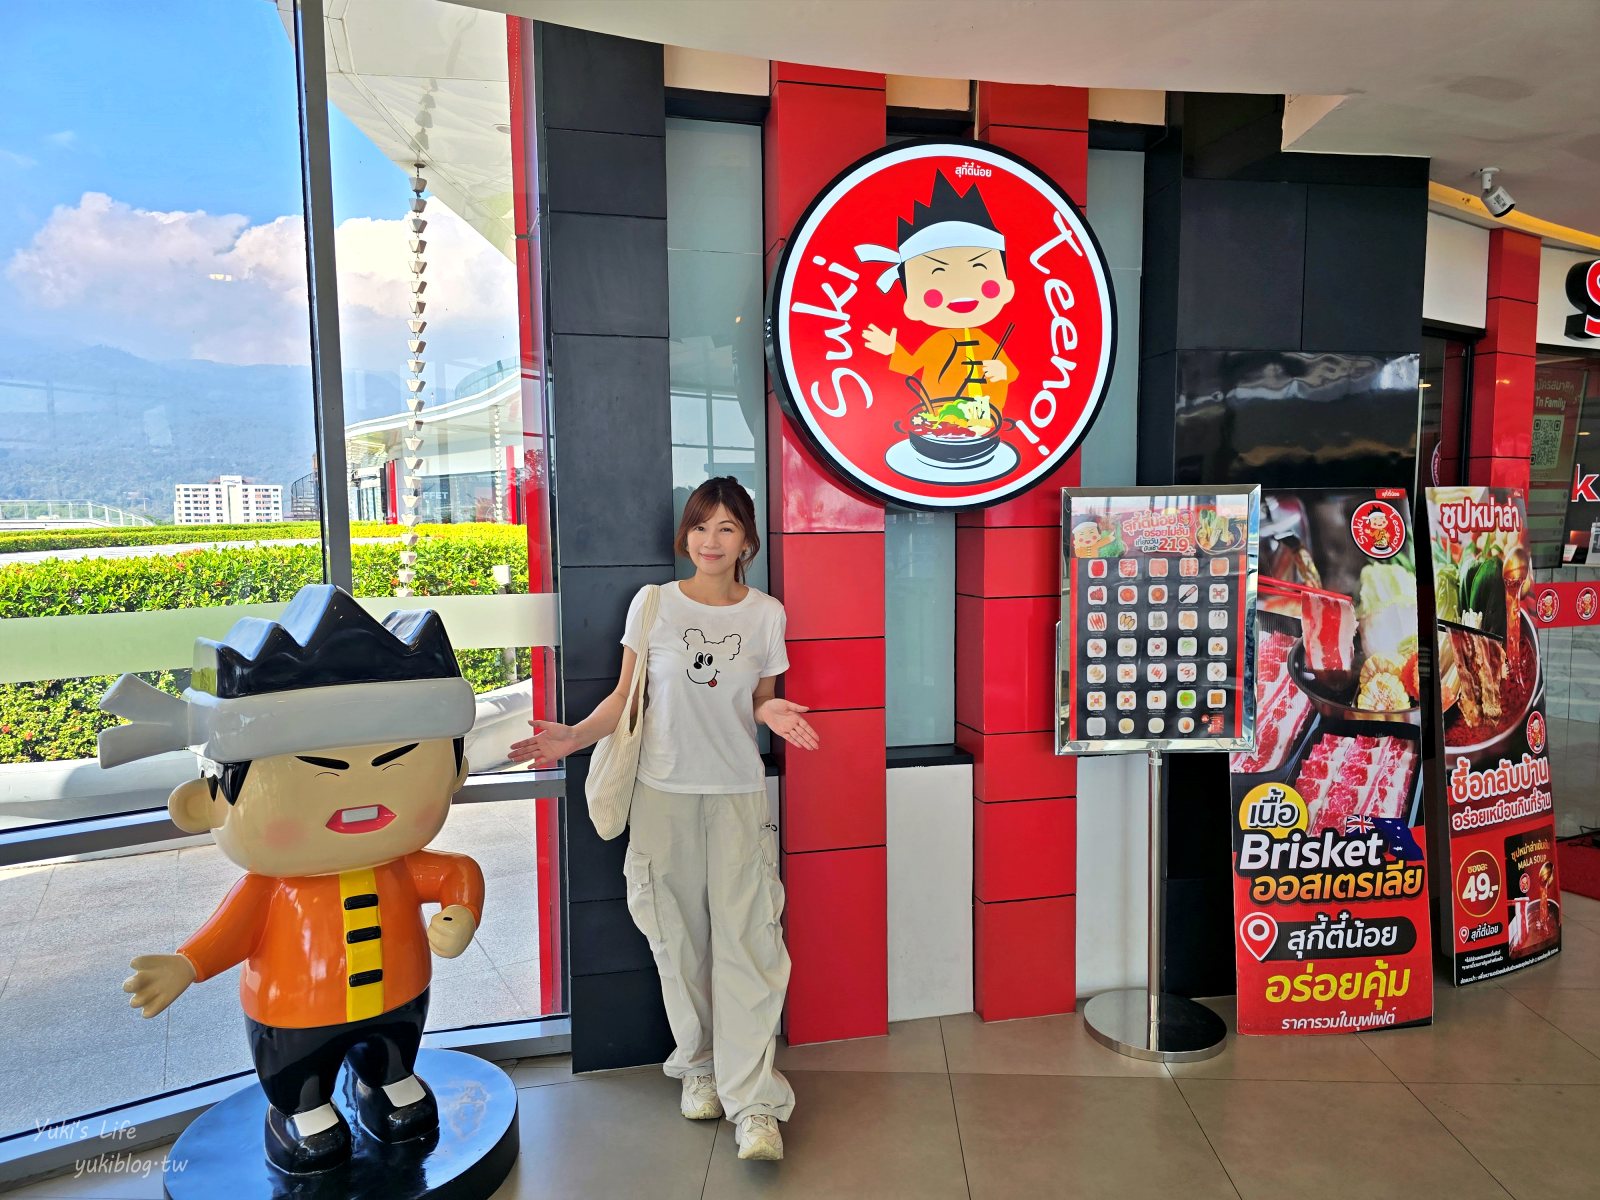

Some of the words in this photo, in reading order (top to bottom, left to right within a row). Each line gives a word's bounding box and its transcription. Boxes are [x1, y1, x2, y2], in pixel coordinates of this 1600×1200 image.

[955, 161, 992, 178] สุกี้ตี๋น้อย
[791, 255, 873, 418] Suki
[1029, 210, 1084, 456] Teenoi
[1441, 496, 1520, 540] ซุปหม่าล่า
[1158, 537, 1189, 552] 219
[1451, 753, 1549, 802] ซื้อกลับบ้าน
[1246, 788, 1299, 828] เนื้อ
[1452, 787, 1551, 830] อร่อยเหมือนกินที่ร้าน
[1240, 832, 1384, 870] Brisket
[1517, 856, 1533, 870] MALA
[1253, 860, 1422, 901] ออสเตรเลีย
[1287, 911, 1397, 959] สุกี้ตี๋น้อย
[1265, 960, 1411, 1010] อร่อยคุ้ม
